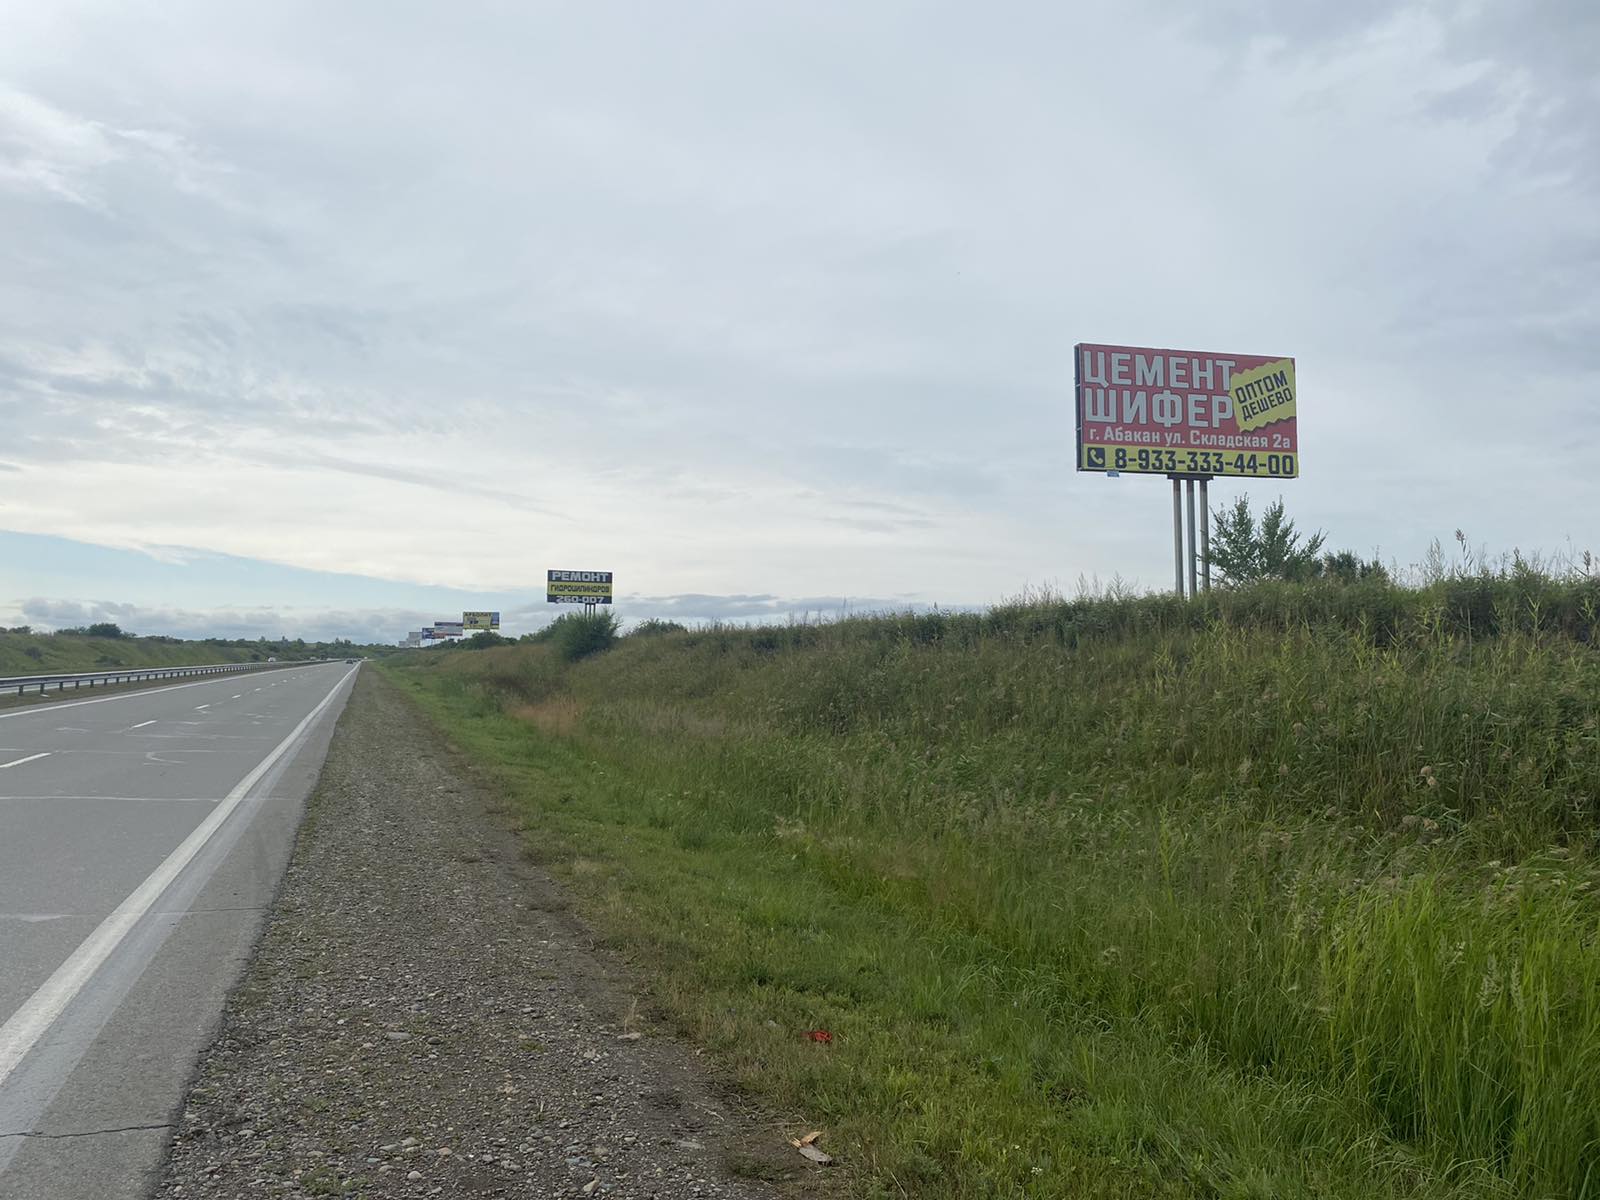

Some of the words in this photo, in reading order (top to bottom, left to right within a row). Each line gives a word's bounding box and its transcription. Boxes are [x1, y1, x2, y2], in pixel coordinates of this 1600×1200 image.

[1083, 350, 1236, 391] ЦЕМЕНТ
[1235, 369, 1288, 404] ОПТОМ
[1084, 387, 1233, 428] ШИФЕР
[1241, 387, 1293, 421] ДЕШЕВО
[1089, 428, 1100, 440] г.
[1103, 426, 1160, 443] Абакан
[1165, 431, 1186, 447] ул.
[1190, 430, 1268, 448] Складская
[1272, 433, 1291, 449] 2а
[1114, 447, 1294, 475] 8-933-333-44-00
[551, 571, 609, 582] РЕМОНТ
